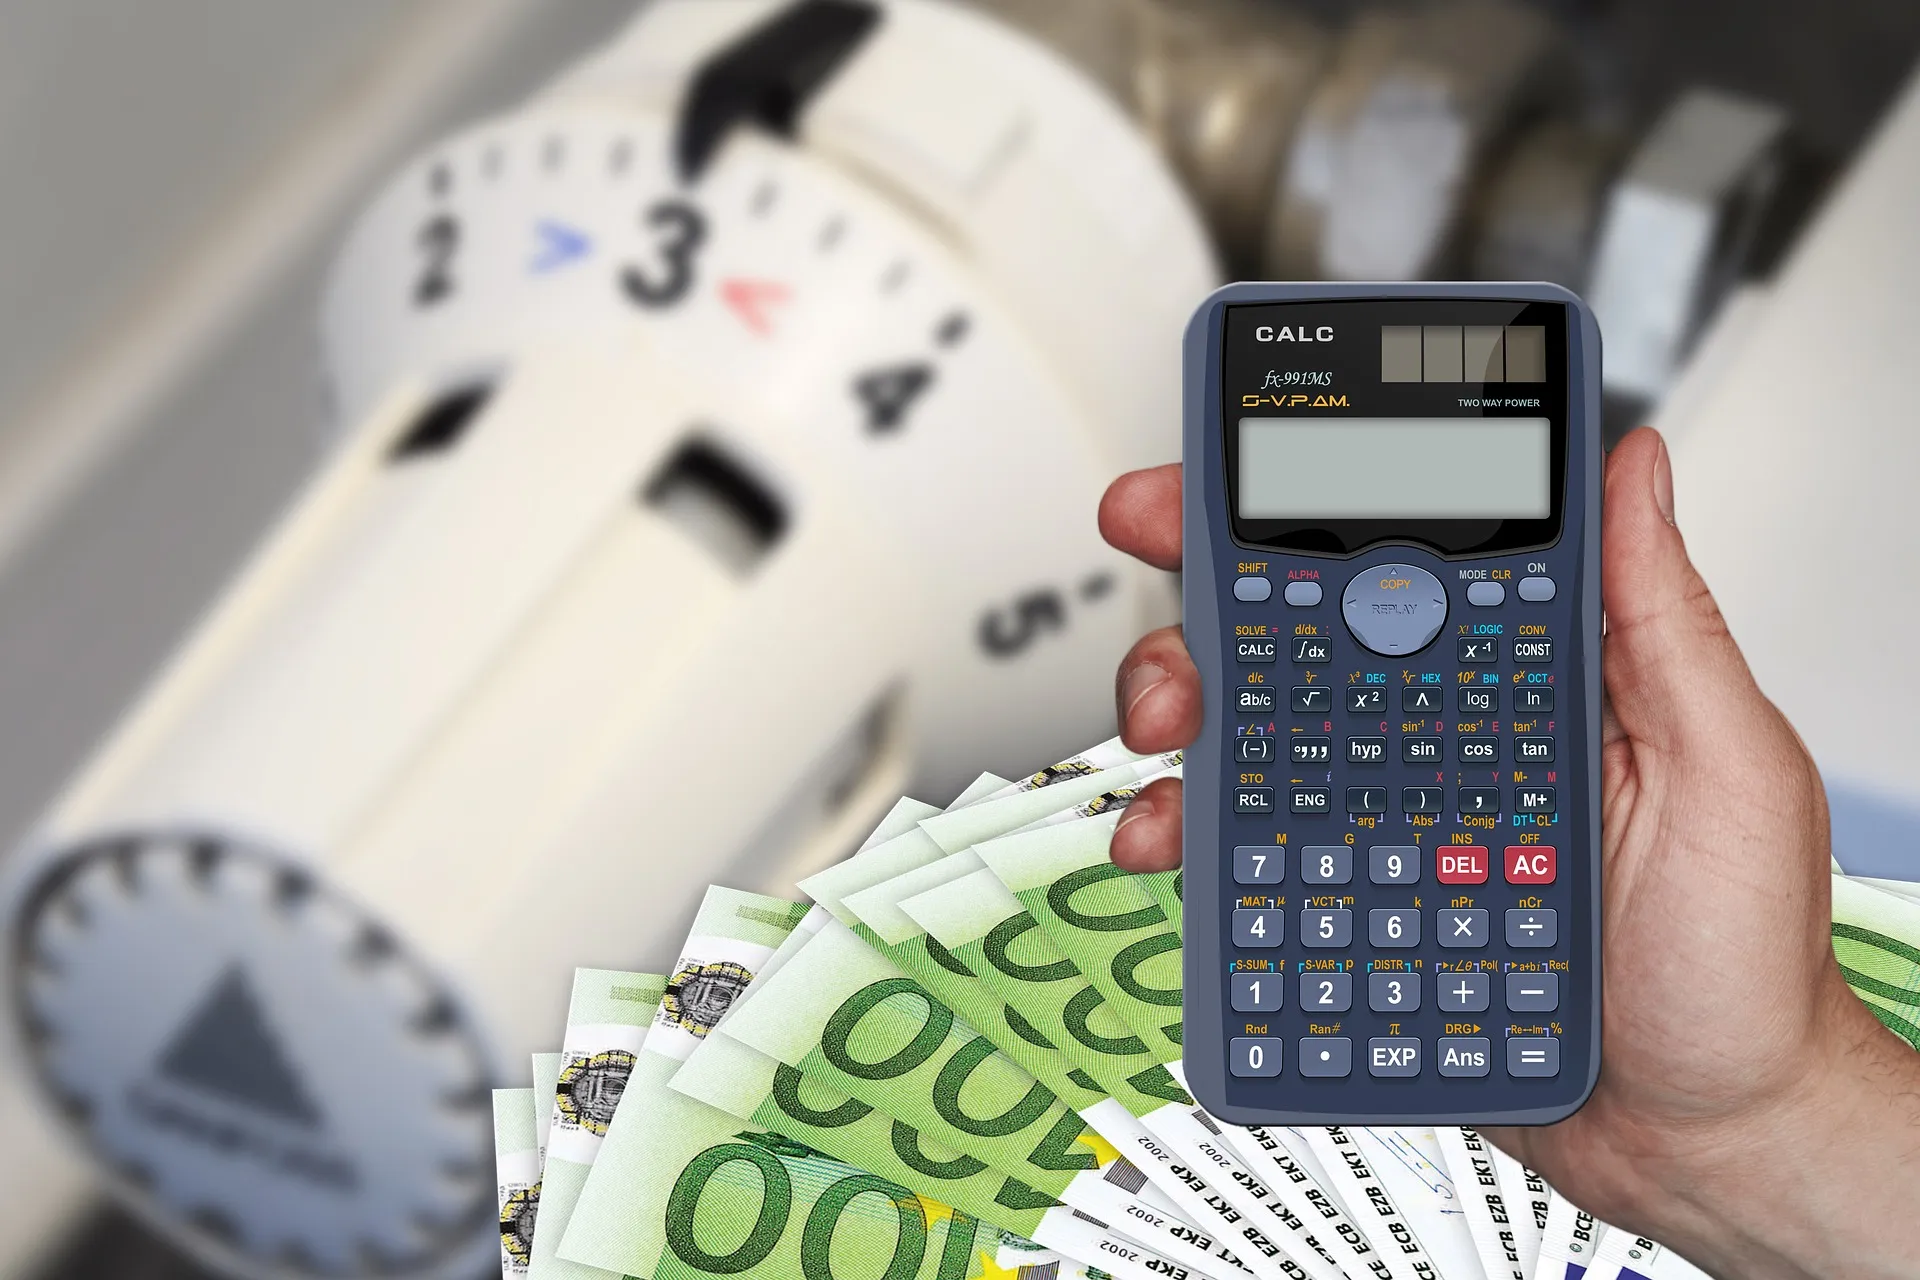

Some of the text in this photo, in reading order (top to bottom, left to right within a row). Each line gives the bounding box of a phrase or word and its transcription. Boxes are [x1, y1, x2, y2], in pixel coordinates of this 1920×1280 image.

[620, 202, 708, 311] 3
[1255, 326, 1335, 343] CALC
[1260, 369, 1333, 390] fx-991MS
[849, 360, 937, 437] 4
[1457, 398, 1541, 407] TWO WAY POWER
[1238, 563, 1268, 573] SHIFT
[1527, 563, 1546, 573] ON
[1288, 570, 1320, 580] ALPHA
[1459, 570, 1511, 580] MODE CLR
[1380, 579, 1412, 589] COPY
[1372, 604, 1417, 615] REPLAY
[976, 586, 1067, 660] 5
[1235, 626, 1267, 635] SOLVE
[1295, 624, 1317, 635] d/dx
[1474, 625, 1503, 634] LOGIC
[1519, 626, 1546, 635] CONV
[1238, 644, 1274, 656] CALC
[1515, 643, 1551, 656] CONST
[1248, 672, 1264, 683] d/c
[1366, 674, 1386, 683] DEC
[1422, 674, 1441, 683] HEX
[1483, 674, 1499, 684] BIN
[1528, 674, 1547, 683] OCT
[1467, 691, 1489, 709] log
[1267, 722, 1276, 732] A
[1324, 721, 1332, 732] B
[1379, 721, 1388, 732] C
[1435, 721, 1444, 732] D
[1492, 721, 1499, 732] E
[1548, 721, 1555, 732] F
[1351, 742, 1381, 759] hyp
[1410, 742, 1435, 756] sin
[1464, 744, 1493, 756] cos
[1522, 742, 1547, 756] tan
[1240, 773, 1264, 784] STO
[1436, 772, 1443, 782] X
[1492, 772, 1499, 782] Y
[1547, 772, 1556, 782] M
[1239, 794, 1268, 806] RCL
[1295, 794, 1325, 806] ENG
[1523, 793, 1547, 807] M+
[1357, 817, 1375, 829] arg
[1412, 815, 1434, 826] Abs
[1463, 815, 1495, 829] Conjg
[1513, 815, 1551, 826] DT CL
[1276, 833, 1287, 844] M
[1344, 833, 1355, 844] G
[1413, 833, 1422, 844] T
[1451, 833, 1473, 844] INS
[1519, 833, 1540, 844] OFF
[1252, 855, 1267, 878] 7
[1319, 855, 1334, 878] 8
[1387, 855, 1402, 878] 9
[1442, 856, 1483, 874] DEL
[1512, 854, 1548, 875] AC
[1242, 896, 1267, 906] MAT
[1312, 896, 1354, 907] VCT m
[1414, 896, 1422, 908] k
[1451, 896, 1474, 908] nPr
[1519, 896, 1542, 908] nCr
[1250, 915, 1266, 939] 4
[1319, 916, 1334, 939] 5
[1387, 915, 1402, 939] 6
[1236, 959, 1285, 971] S-SUM f
[1305, 959, 1335, 970] S-VAR
[1374, 959, 1423, 970] DISTR n
[1249, 981, 1260, 1004] 1
[1318, 981, 1334, 1004] 2
[1387, 981, 1402, 1005] 3
[1245, 1024, 1268, 1034] Rnd
[1446, 1024, 1472, 1034] DRG
[1248, 1045, 1264, 1069] 0
[1373, 1048, 1416, 1066] EXP
[1443, 1048, 1485, 1067] Ans
[1137, 1135, 1171, 1162] 2002
[1199, 1141, 1232, 1169] 2002
[1274, 1154, 1308, 1184] EKT
[1471, 1157, 1496, 1186] EKT
[1170, 1164, 1207, 1194] EKP
[1232, 1171, 1269, 1199] EKP
[1305, 1189, 1339, 1219] EZB
[1325, 1126, 1437, 1280] CE ECB EZB EKT EK
[1486, 1194, 1510, 1224] EZB
[1126, 1203, 1165, 1228] 2002
[1204, 1195, 1242, 1224] EKT
[1266, 1202, 1304, 1231] EKT
[1169, 1226, 1213, 1252] EKP
[1242, 1227, 1280, 1258] EZB
[1336, 1222, 1371, 1255] ECB
[1099, 1239, 1140, 1262] 2002
[1367, 1260, 1394, 1280] CE
